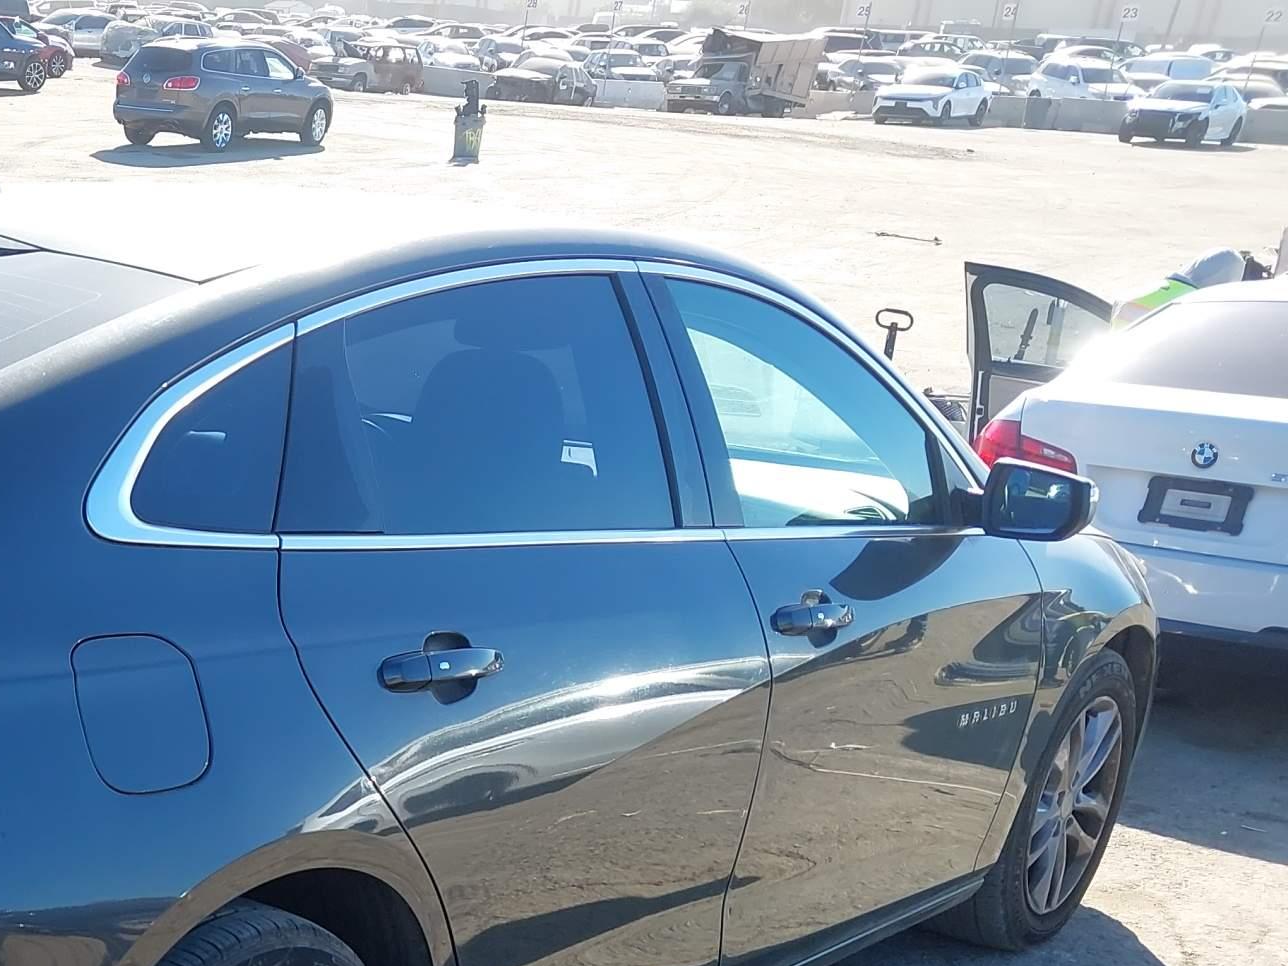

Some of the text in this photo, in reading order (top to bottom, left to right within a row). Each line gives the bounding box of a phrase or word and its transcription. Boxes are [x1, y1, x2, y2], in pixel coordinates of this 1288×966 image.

[614, 1, 623, 11] 27
[857, 6, 871, 16] 25
[1122, 7, 1138, 19] 23
[1265, 10, 1283, 23] 22
[959, 700, 1017, 728] MALIBU
